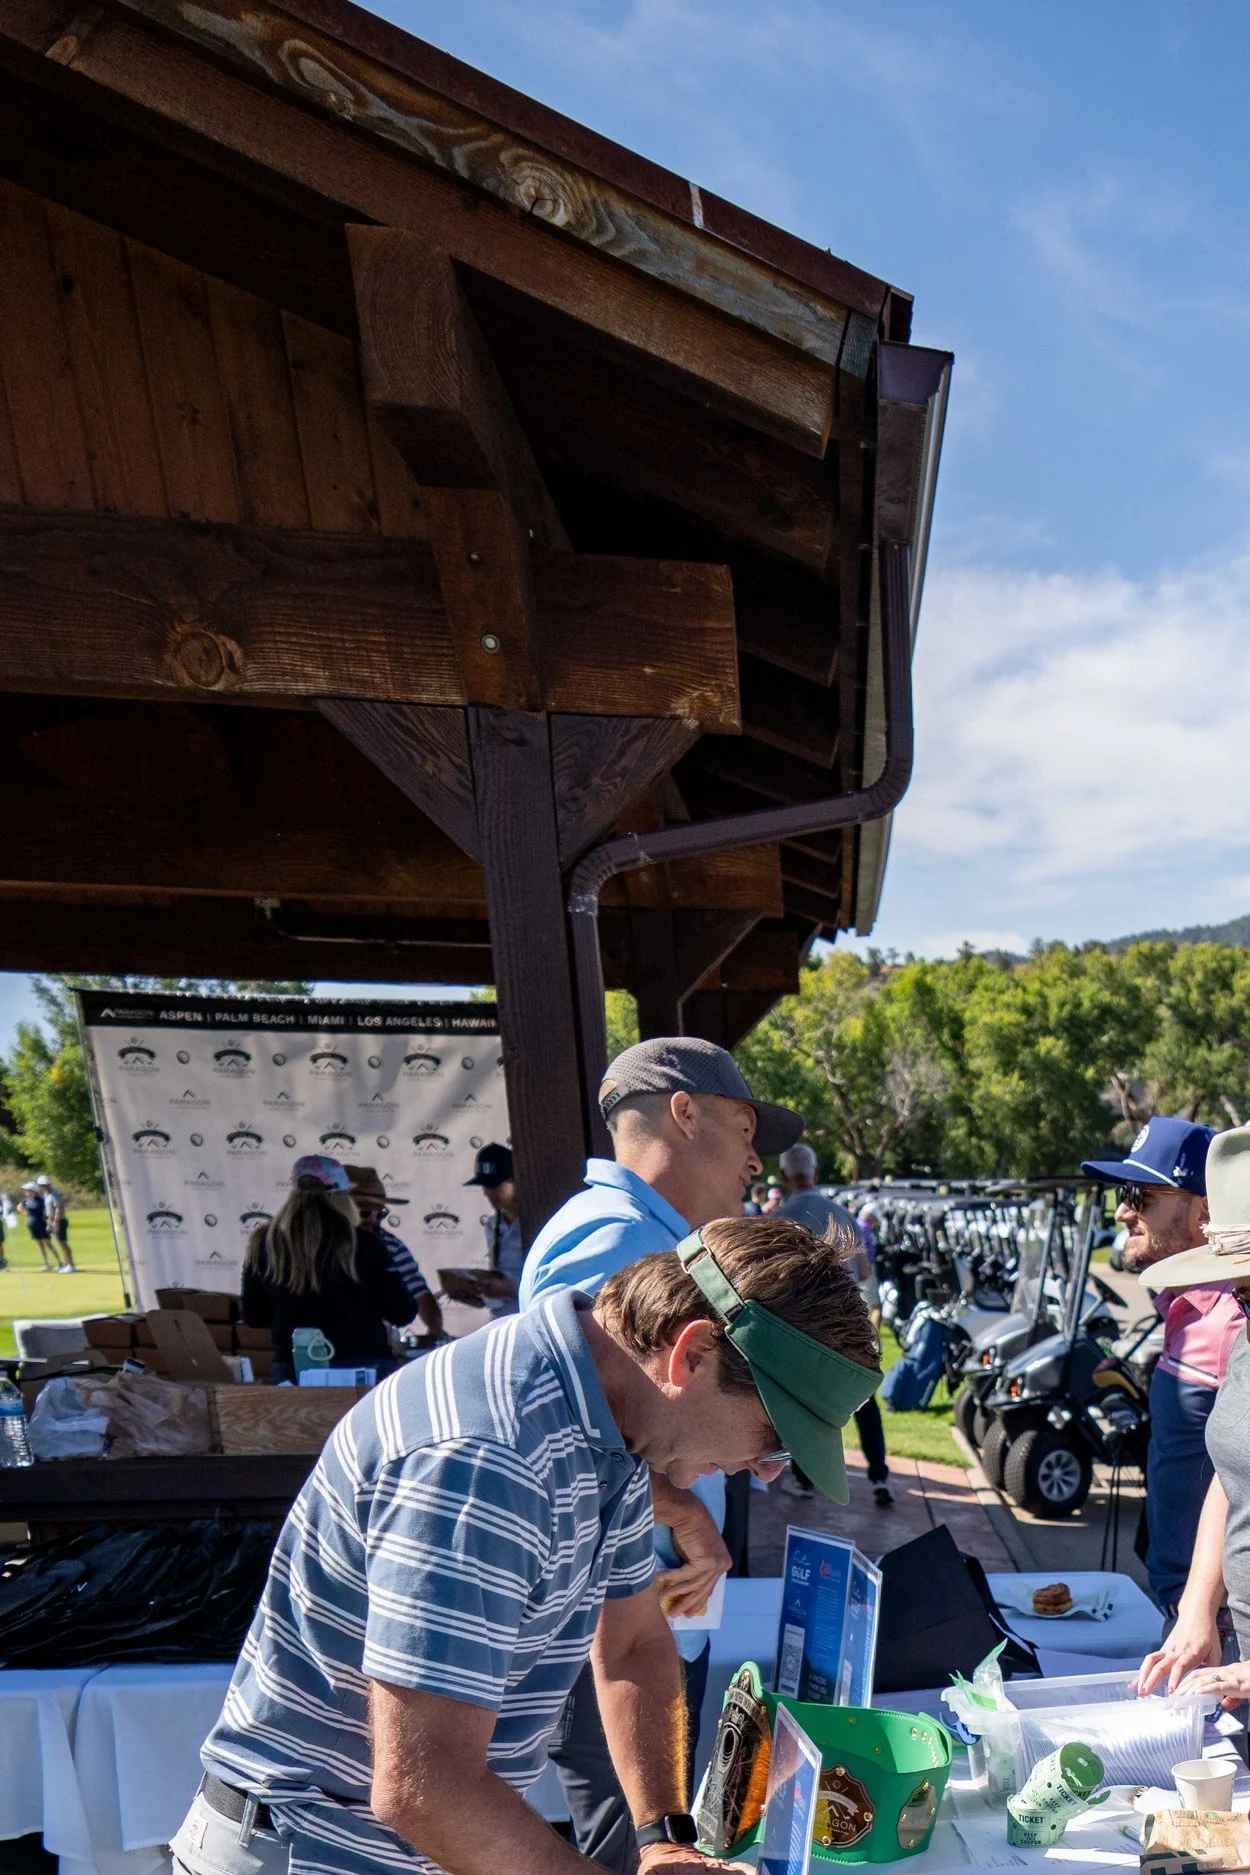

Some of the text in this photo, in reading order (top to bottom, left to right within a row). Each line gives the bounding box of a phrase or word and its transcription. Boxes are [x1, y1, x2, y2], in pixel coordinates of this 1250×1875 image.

[159, 1010, 202, 1022] ASPEN
[215, 1012, 248, 1023] PALM
[252, 1013, 296, 1024] BEACH
[307, 1015, 345, 1025] MIAMI
[357, 1016, 381, 1026] LOS
[385, 1017, 442, 1027] ANGELES
[1056, 1784, 1079, 1806] TICKET
[1018, 1813, 1045, 1824] TICKET
